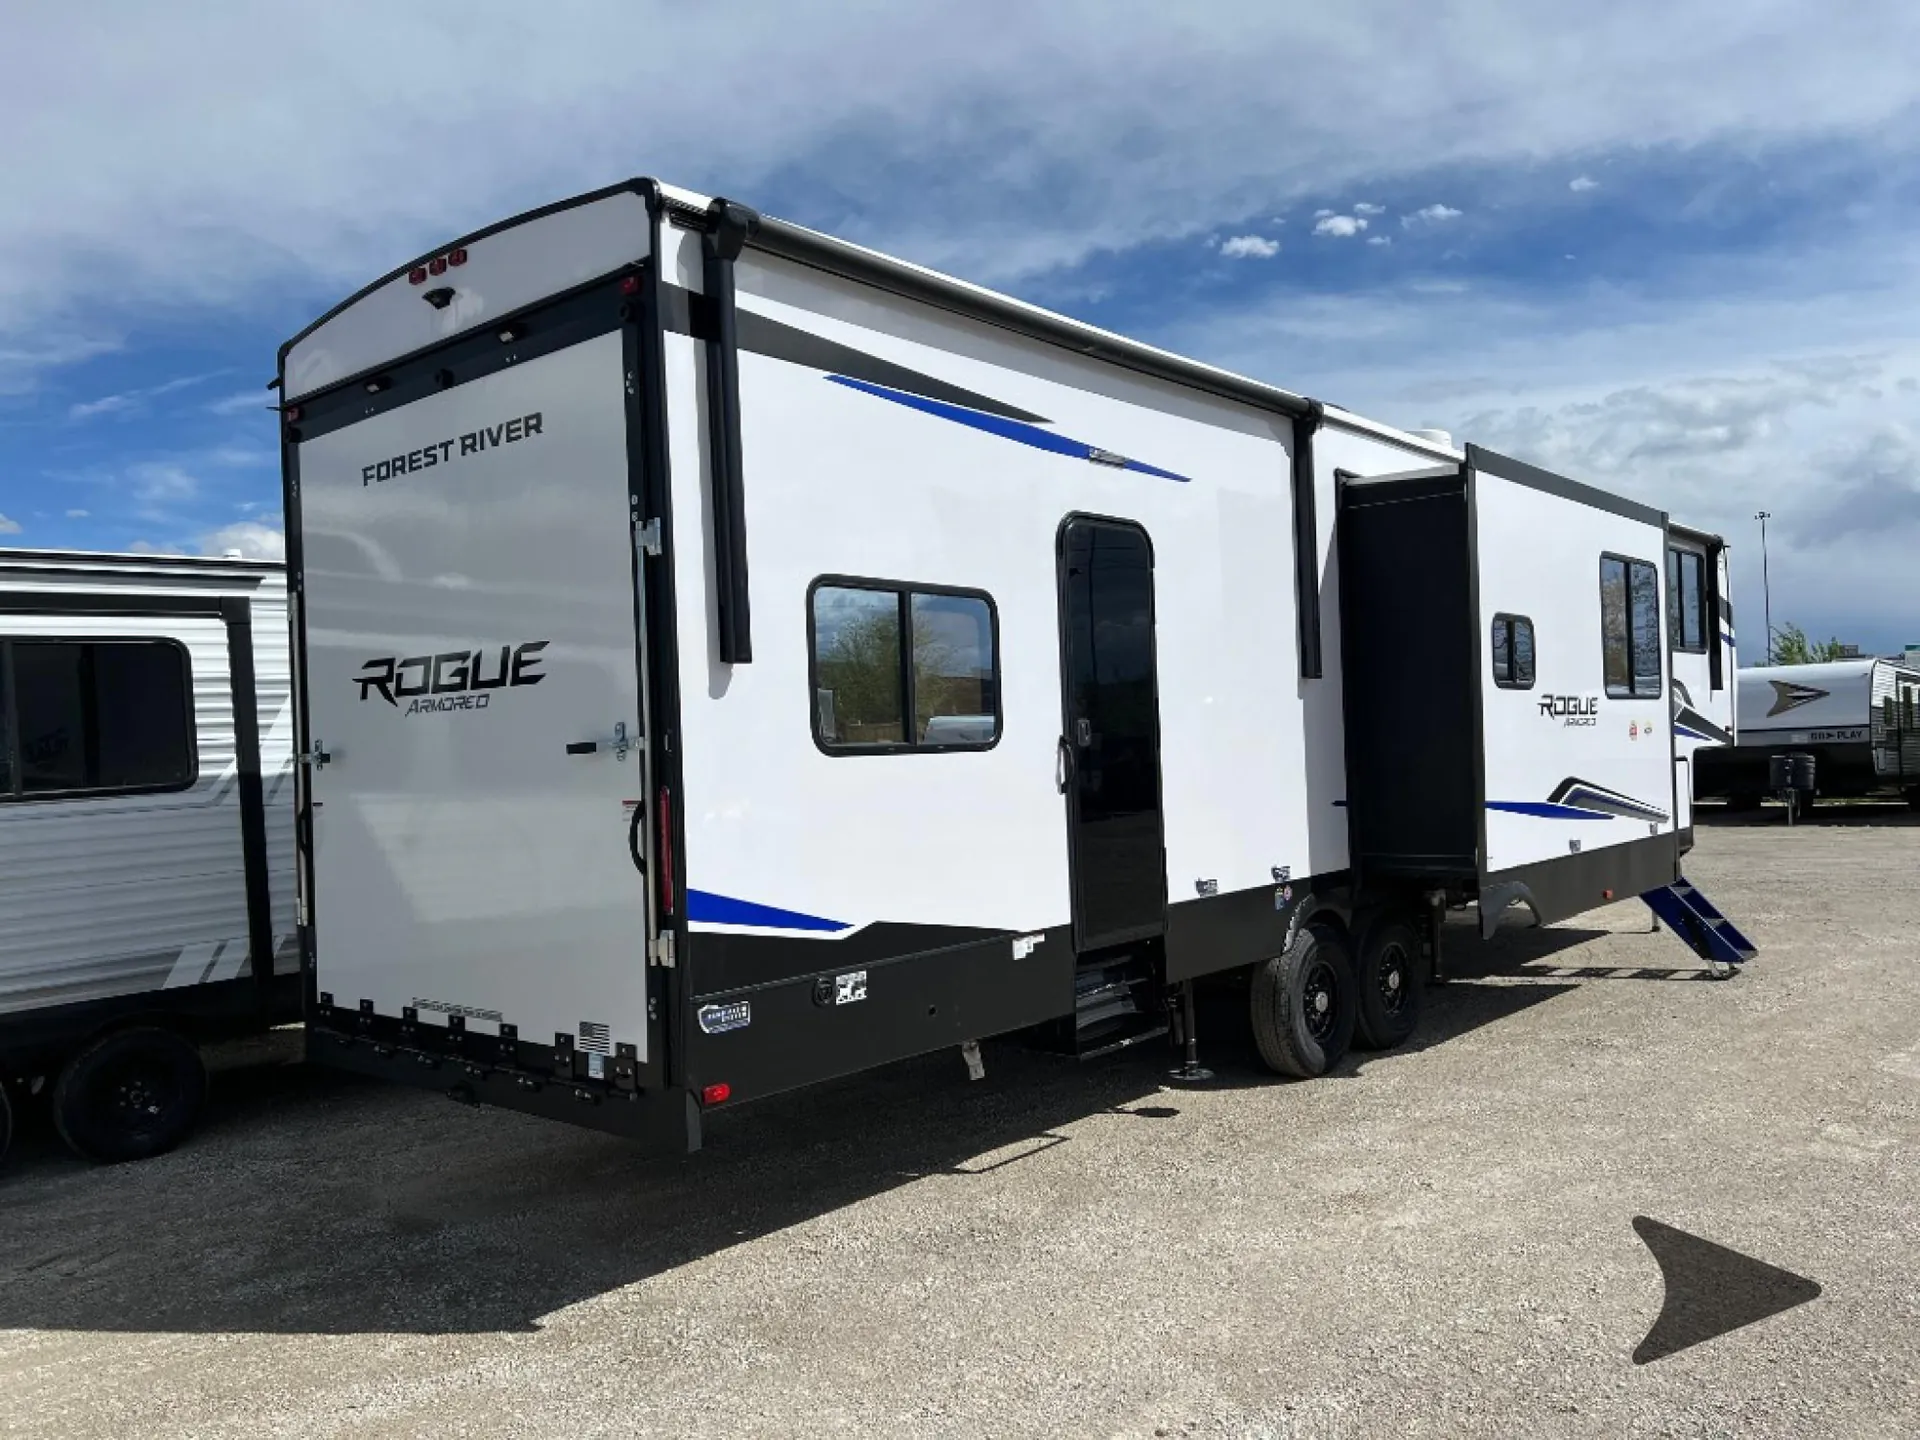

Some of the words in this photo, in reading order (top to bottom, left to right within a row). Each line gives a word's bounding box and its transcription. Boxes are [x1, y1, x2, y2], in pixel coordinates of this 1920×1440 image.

[361, 438, 455, 487] FOREST
[459, 411, 544, 457] RIVER
[352, 640, 550, 707] ROGUE
[404, 693, 491, 718] ARMORED
[1537, 694, 1598, 720] ROGUE
[1836, 730, 1863, 740] PLAY
